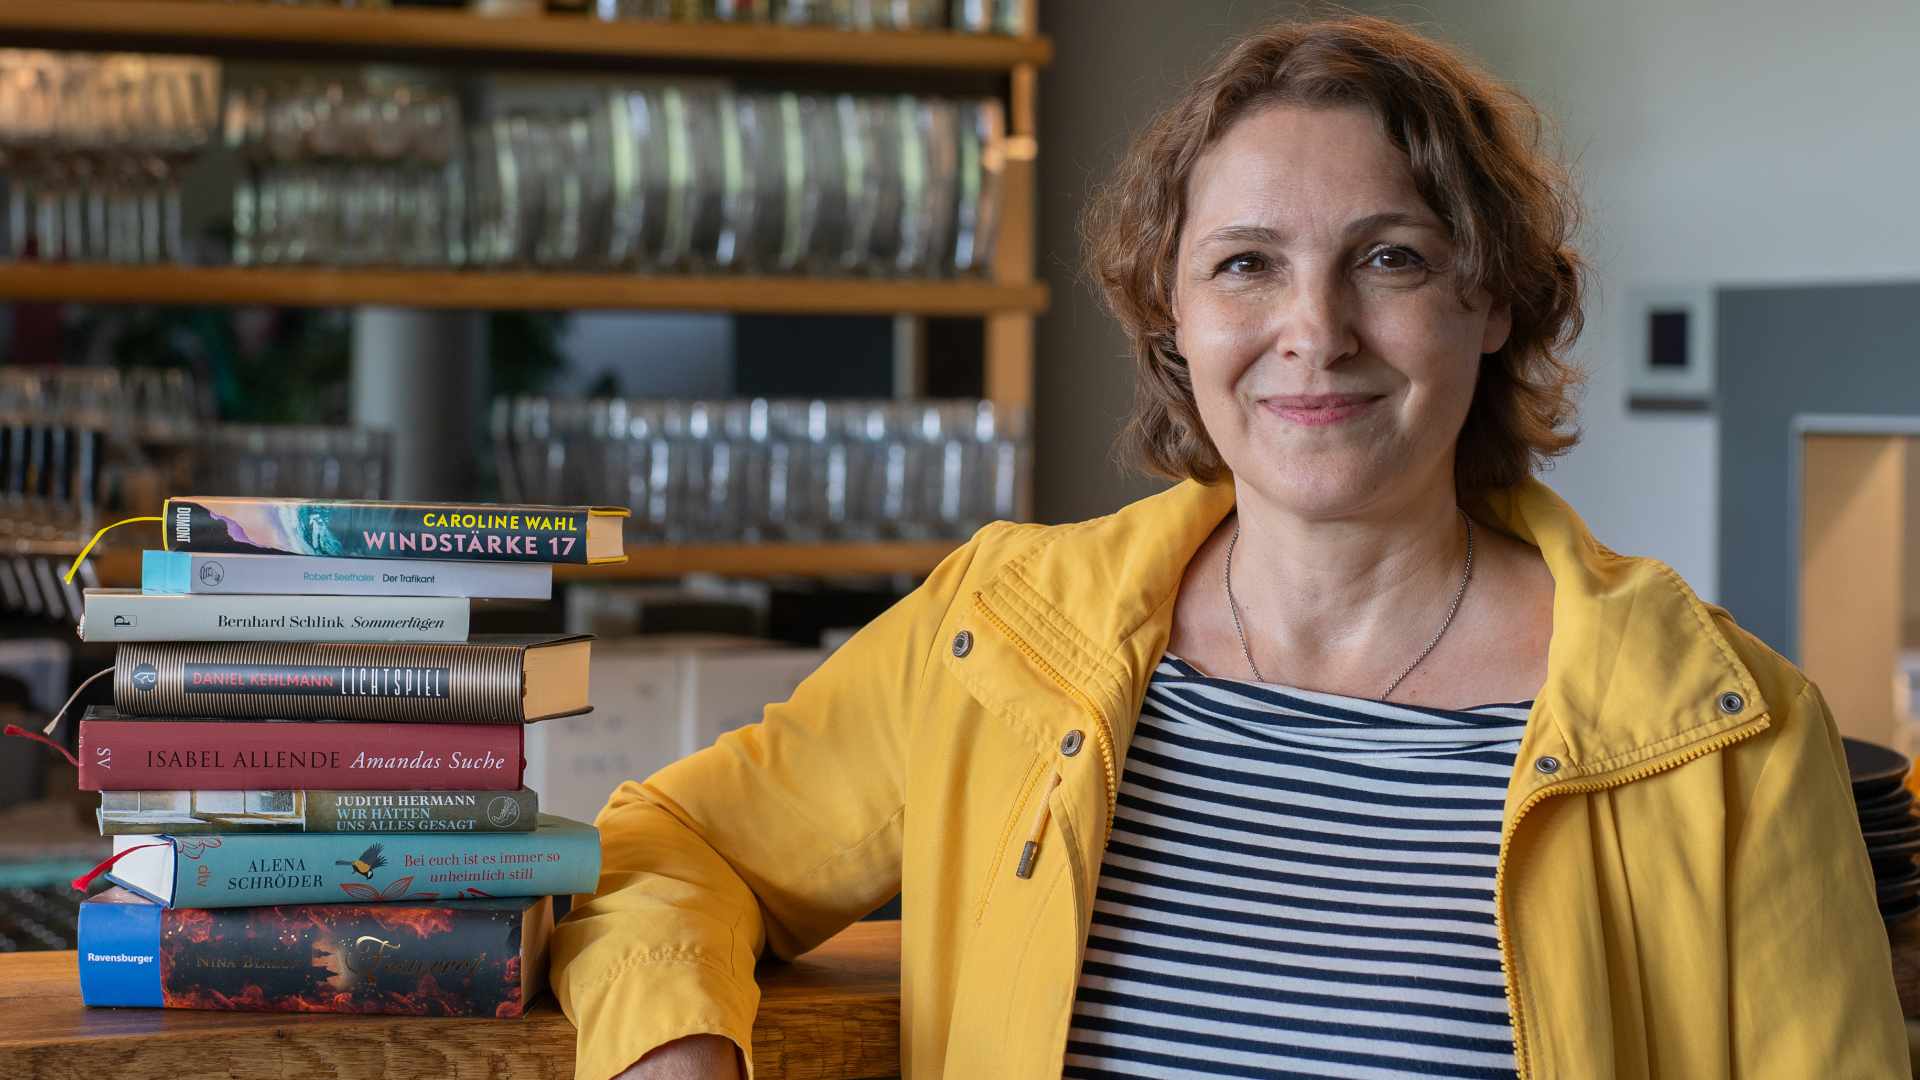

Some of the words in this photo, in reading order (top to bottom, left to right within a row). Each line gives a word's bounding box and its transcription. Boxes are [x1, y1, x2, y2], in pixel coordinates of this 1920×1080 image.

[176, 507, 192, 544] DUMONT
[423, 513, 519, 530] CAROLINE
[524, 516, 577, 532] WAHL
[363, 530, 538, 555] WINDSTÄRKE
[548, 537, 577, 556] 17
[303, 571, 333, 582] Robert
[382, 573, 398, 583] Der
[400, 573, 435, 584] Trafikant
[218, 614, 286, 629] Bernhard
[289, 614, 346, 629] Schlink
[351, 615, 446, 632] Sommerlügen
[192, 671, 245, 687] DANIEL
[249, 671, 334, 688] KEHLMANN
[341, 667, 442, 697] LICHTSPIEL
[96, 746, 112, 769] SV
[147, 750, 226, 768] ISABEL
[232, 750, 341, 769] ALLENDE
[349, 751, 442, 769] Amandas
[448, 751, 505, 769] Suche
[335, 795, 393, 807] JUDITH
[398, 795, 476, 806] HERMANN
[336, 808, 367, 820] WIR
[371, 807, 430, 820] HÄTTEN
[336, 820, 366, 831] UNS
[367, 820, 416, 831] ALLES
[418, 819, 476, 831] GESAGT
[248, 858, 306, 873] ALENA
[404, 854, 424, 867] Bei
[428, 853, 460, 866] euch
[463, 853, 479, 865] ist
[482, 855, 497, 865] es
[500, 852, 544, 864] immer
[546, 854, 561, 863] so
[227, 874, 324, 890] SCHRÖDER
[429, 869, 505, 884] unheimlich
[508, 867, 534, 880] still
[87, 952, 154, 965] Ravensburger
